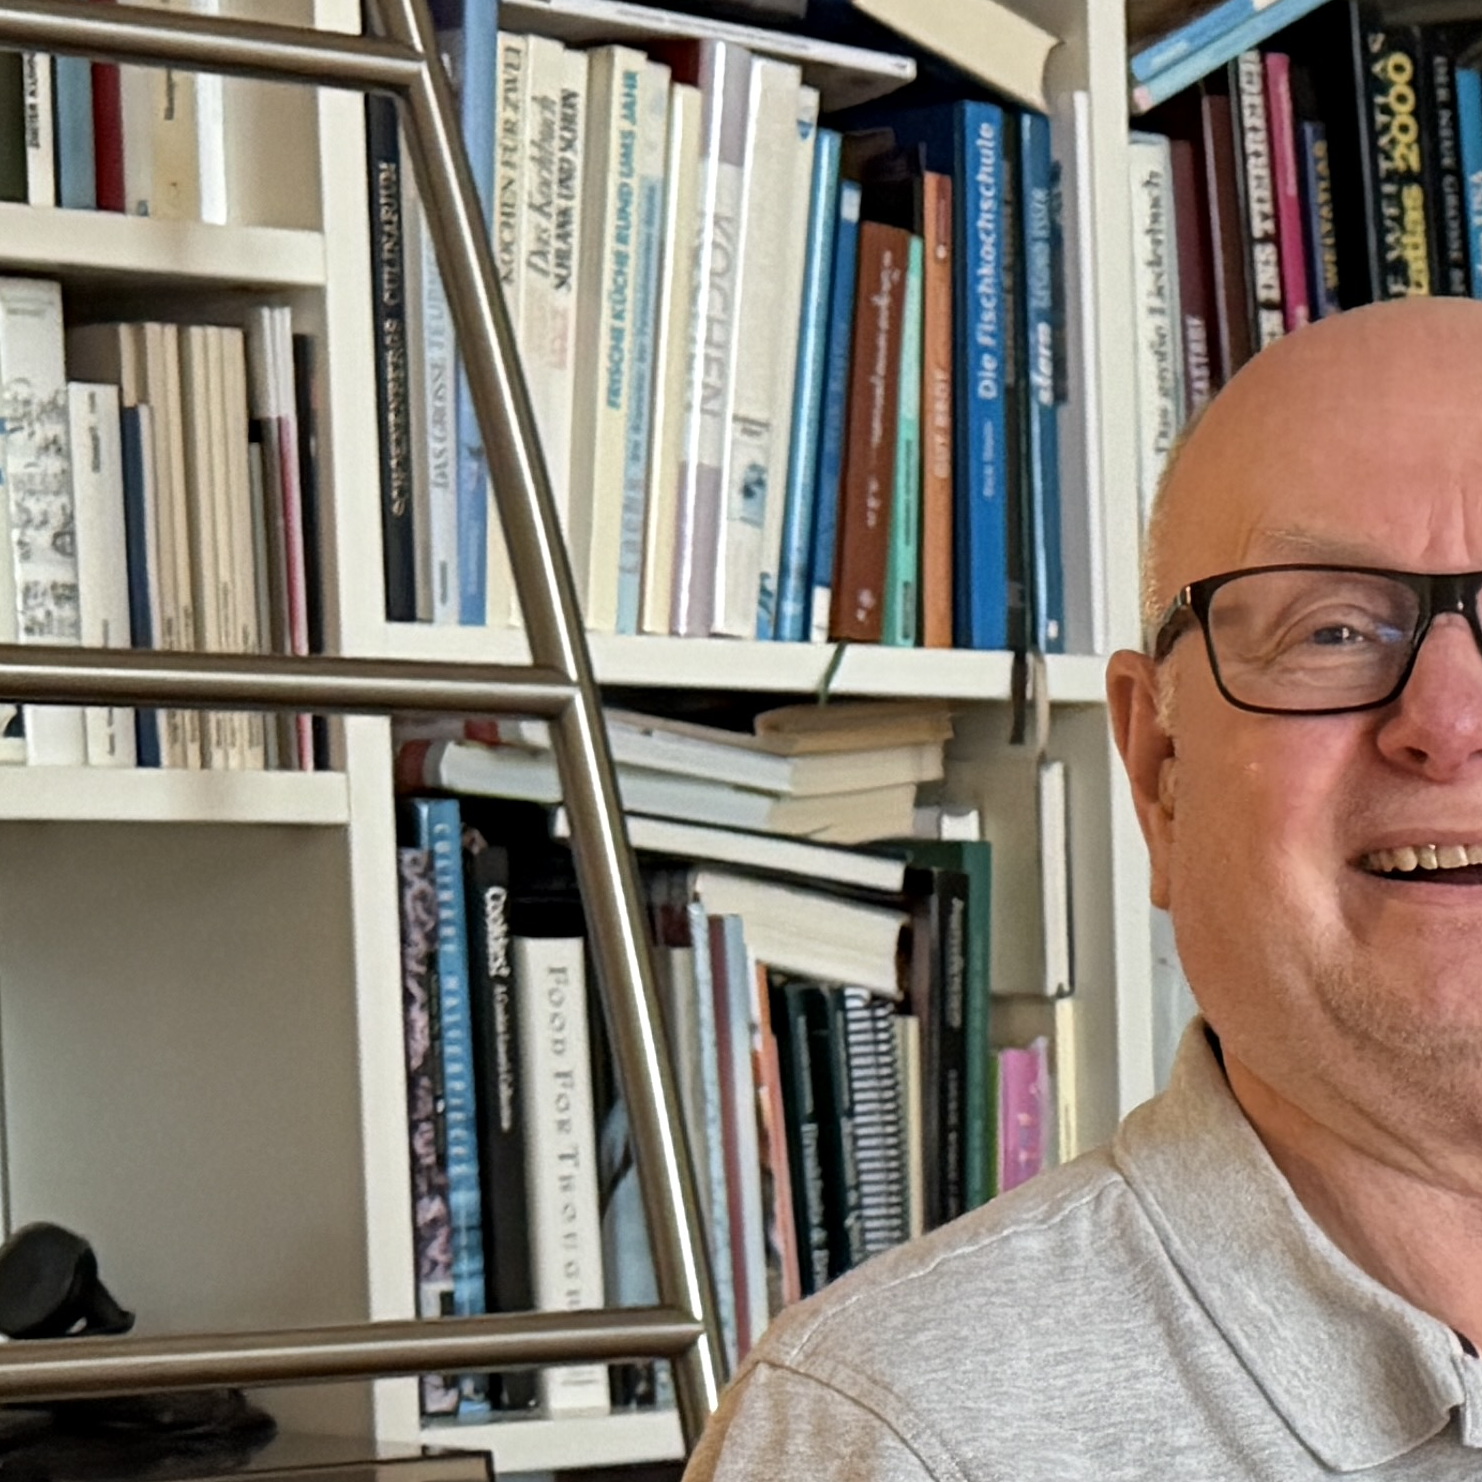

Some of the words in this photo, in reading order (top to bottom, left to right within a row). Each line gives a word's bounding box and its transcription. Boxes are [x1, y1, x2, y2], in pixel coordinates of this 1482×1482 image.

[502, 45, 522, 112] ZWEI
[622, 71, 639, 126] JAHR
[1387, 51, 1421, 174] 2000
[528, 95, 558, 220] Kochbuch
[498, 178, 516, 287] KOCHEN
[526, 224, 553, 279] Das
[614, 184, 634, 246] RUND
[975, 121, 998, 347] Fischkochschule
[1142, 169, 1168, 316] Liederbuch
[609, 250, 631, 321] KÜCHE
[606, 326, 627, 410] FRISCHE
[977, 356, 999, 400] Die
[433, 822, 458, 954] CULINARY
[557, 1143, 582, 1309] THOUGH
